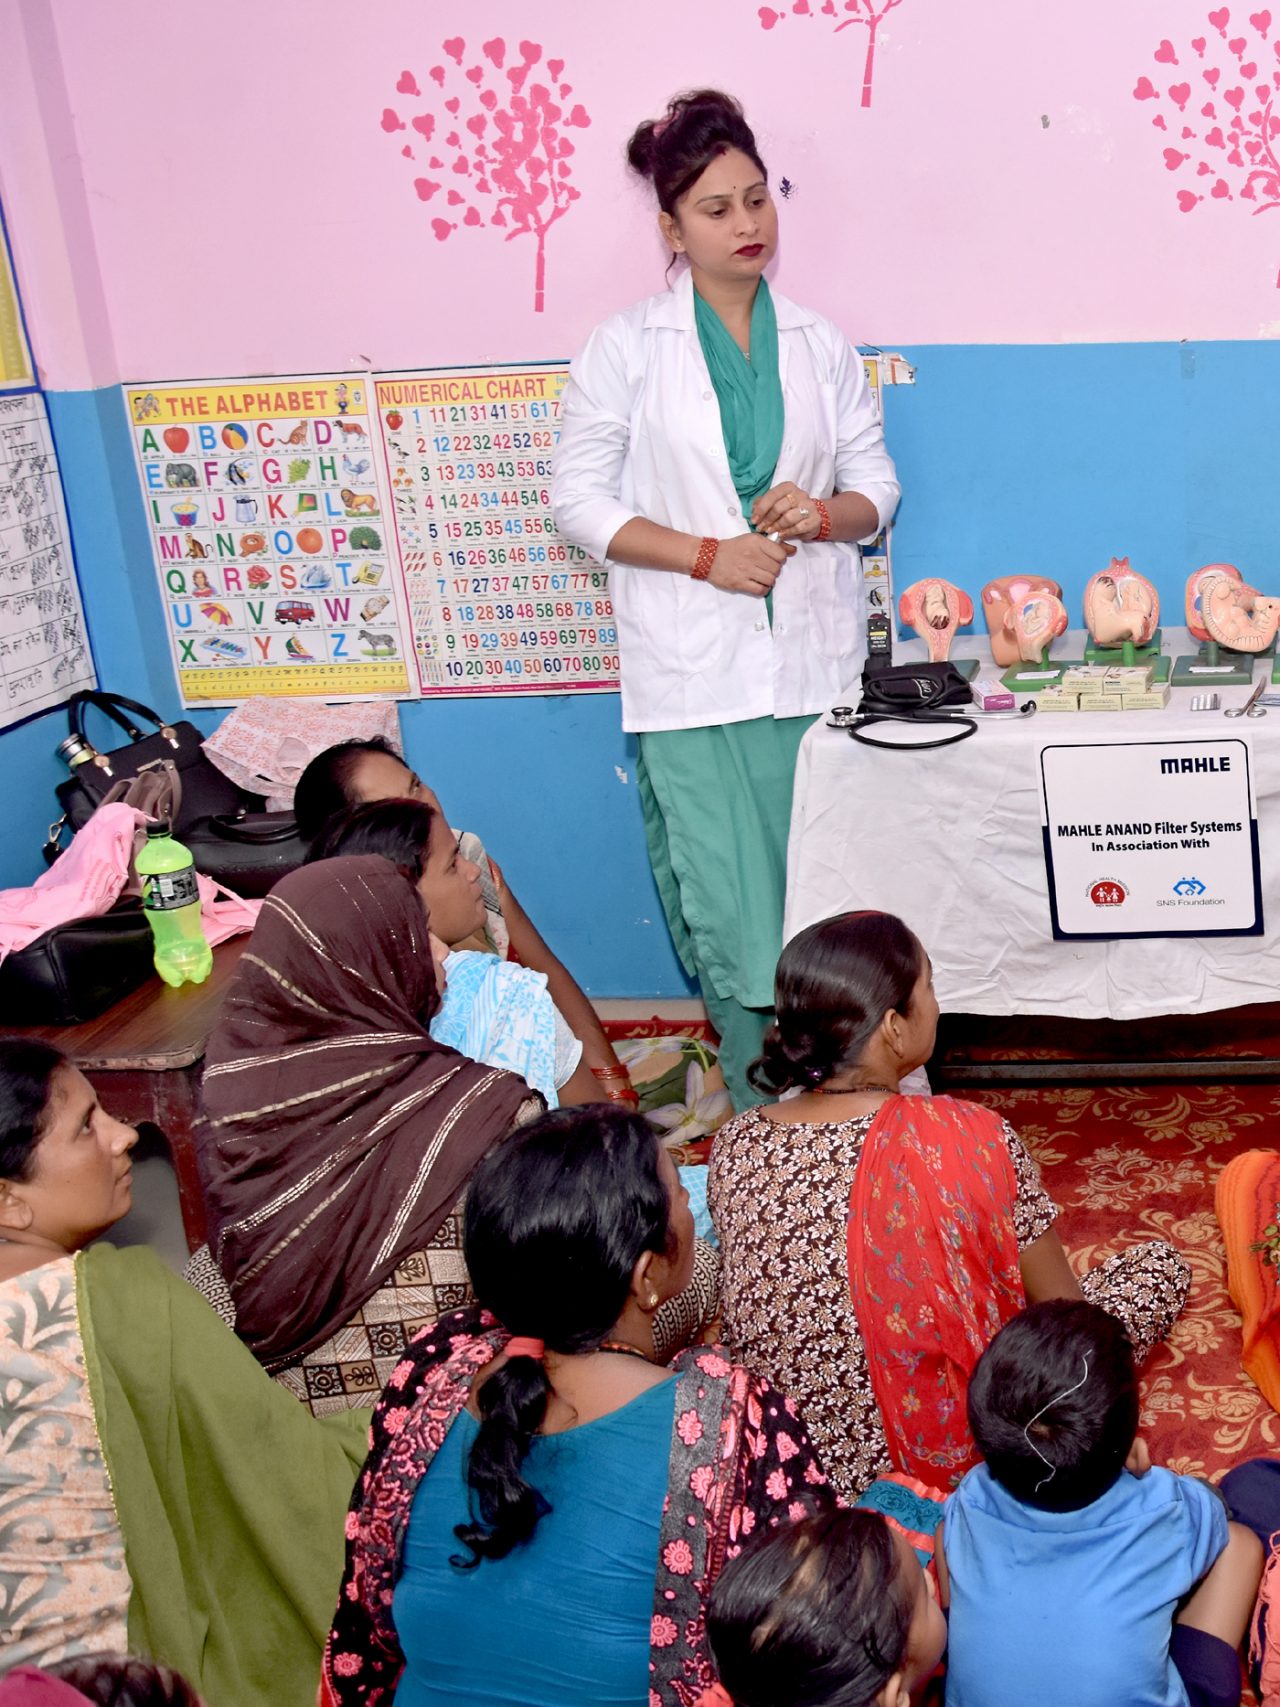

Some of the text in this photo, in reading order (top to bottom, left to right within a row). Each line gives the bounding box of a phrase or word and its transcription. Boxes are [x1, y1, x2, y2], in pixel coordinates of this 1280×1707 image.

[379, 382, 483, 404] NUMERICAL
[487, 378, 546, 399] CHART
[166, 390, 328, 416] THE ALPHABET
[413, 409, 419, 424] 1
[430, 408, 446, 423] 11
[450, 407, 466, 422] 21
[470, 405, 486, 421] 31
[491, 405, 506, 419] 41
[511, 403, 526, 419] 51
[531, 402, 547, 418] 61
[142, 420, 331, 453] A B C D
[417, 438, 426, 453] 2
[433, 437, 450, 452] 12
[454, 436, 472, 451] 22
[473, 435, 491, 450] 32
[493, 434, 511, 449] 42
[514, 433, 531, 448] 52
[533, 432, 552, 447] 62
[146, 456, 337, 488] E F G H
[421, 466, 430, 481] 3
[437, 465, 454, 480] 13
[457, 464, 475, 479] 23
[477, 463, 495, 478] 33
[497, 462, 514, 477] 43
[518, 462, 535, 476] 53
[152, 493, 342, 523] I J K L
[425, 495, 434, 510] 4
[440, 494, 458, 509] 14
[460, 493, 479, 508] 24
[480, 492, 499, 507] 34
[501, 491, 519, 506] 44
[521, 490, 538, 505] 54
[429, 524, 437, 538] 5
[445, 523, 461, 537] 15
[464, 521, 482, 536] 25
[485, 520, 502, 535] 35
[505, 520, 522, 534] 45
[525, 519, 542, 533] 55
[160, 529, 347, 559] M N O P
[433, 552, 442, 566] 6
[448, 551, 465, 565] 16
[468, 550, 486, 565] 26
[488, 549, 506, 564] 36
[509, 548, 526, 562] 46
[528, 547, 546, 562] 56
[548, 546, 566, 561] 66
[166, 563, 352, 593] Q R S T
[437, 572, 608, 593] 7 17 27 37 47 57 67 77 87
[173, 598, 350, 628] U V W
[442, 601, 613, 621] 8 18 28 38 48 58 68 78 88
[178, 633, 348, 662] X Y Z
[446, 626, 618, 649] 9 19 29 39 49 59 69 79 89
[446, 656, 620, 676] 10 20 30 40 50 60 70 80 90
[1161, 757, 1230, 774] MAHLE
[1058, 821, 1242, 837] MAHLE ANAND Filter Systems
[1092, 838, 1210, 852] In Association With
[1178, 898, 1225, 906] Foundation
